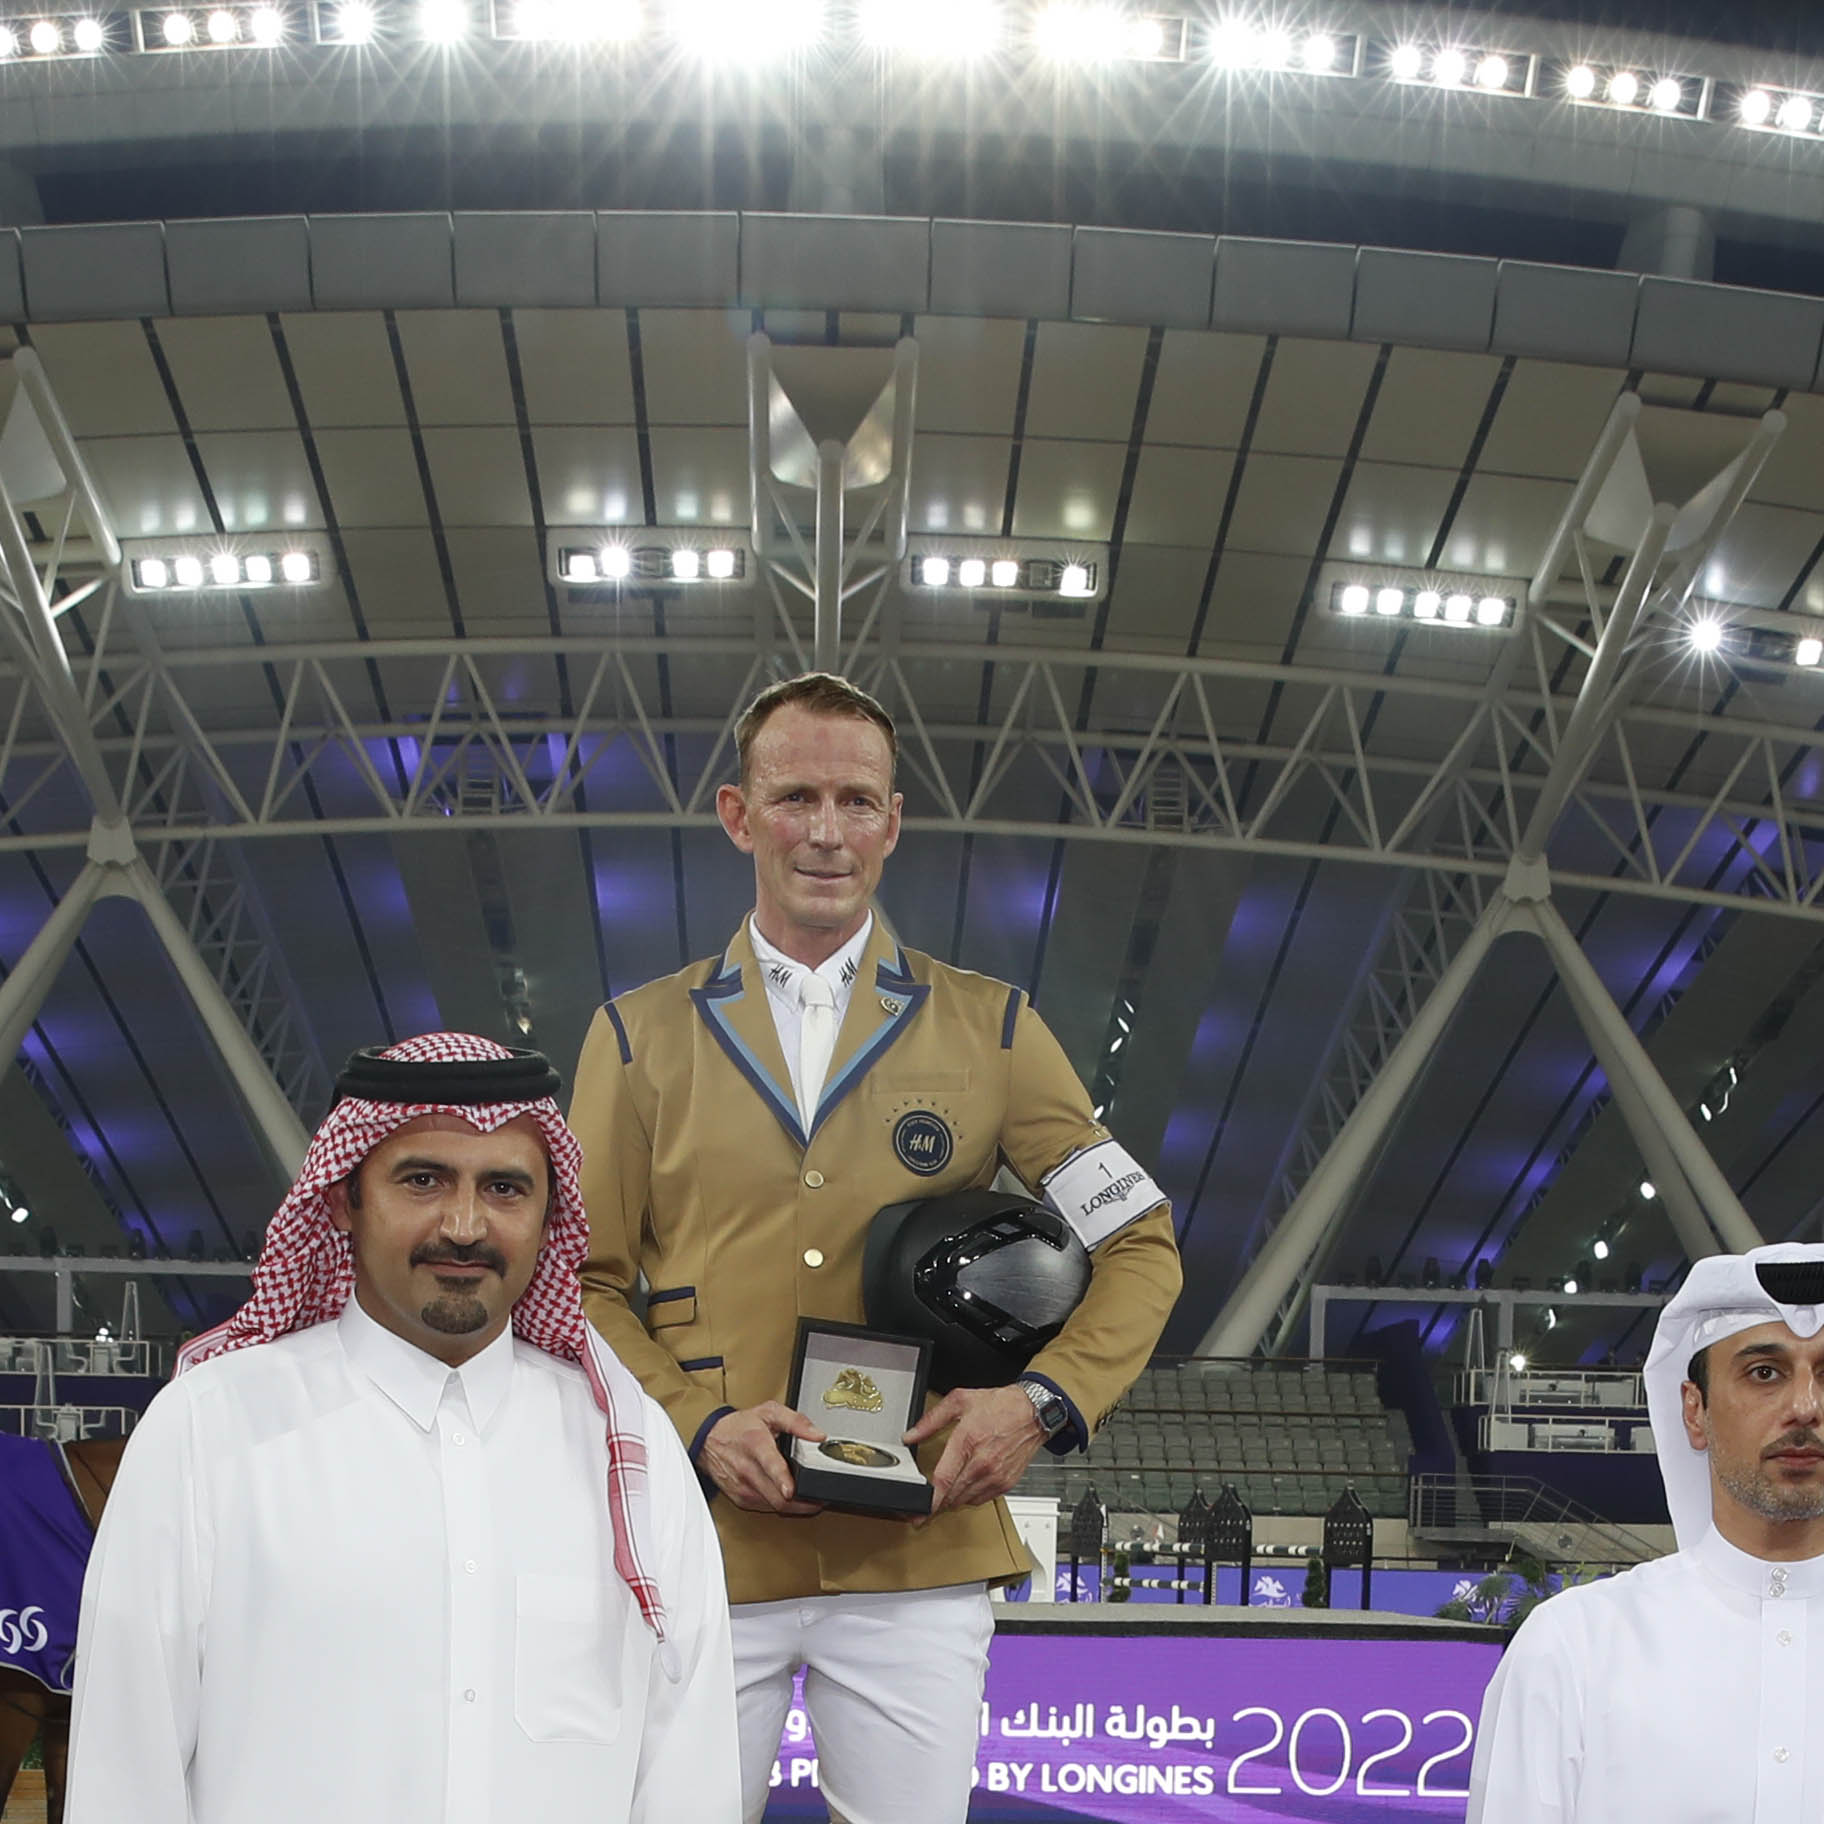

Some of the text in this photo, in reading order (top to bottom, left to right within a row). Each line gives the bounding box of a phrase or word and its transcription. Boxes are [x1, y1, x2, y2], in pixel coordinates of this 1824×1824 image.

[909, 1133, 936, 1153] H&M
[1098, 1161, 1113, 1179] 1
[1080, 1171, 1146, 1217] LONGINES
[1000, 1702, 1094, 1747] البنك
[1104, 1704, 1215, 1750] بطولة
[1227, 1707, 1473, 1798] 2022
[988, 1762, 1033, 1792] BY
[1041, 1763, 1214, 1795] LONGINES
